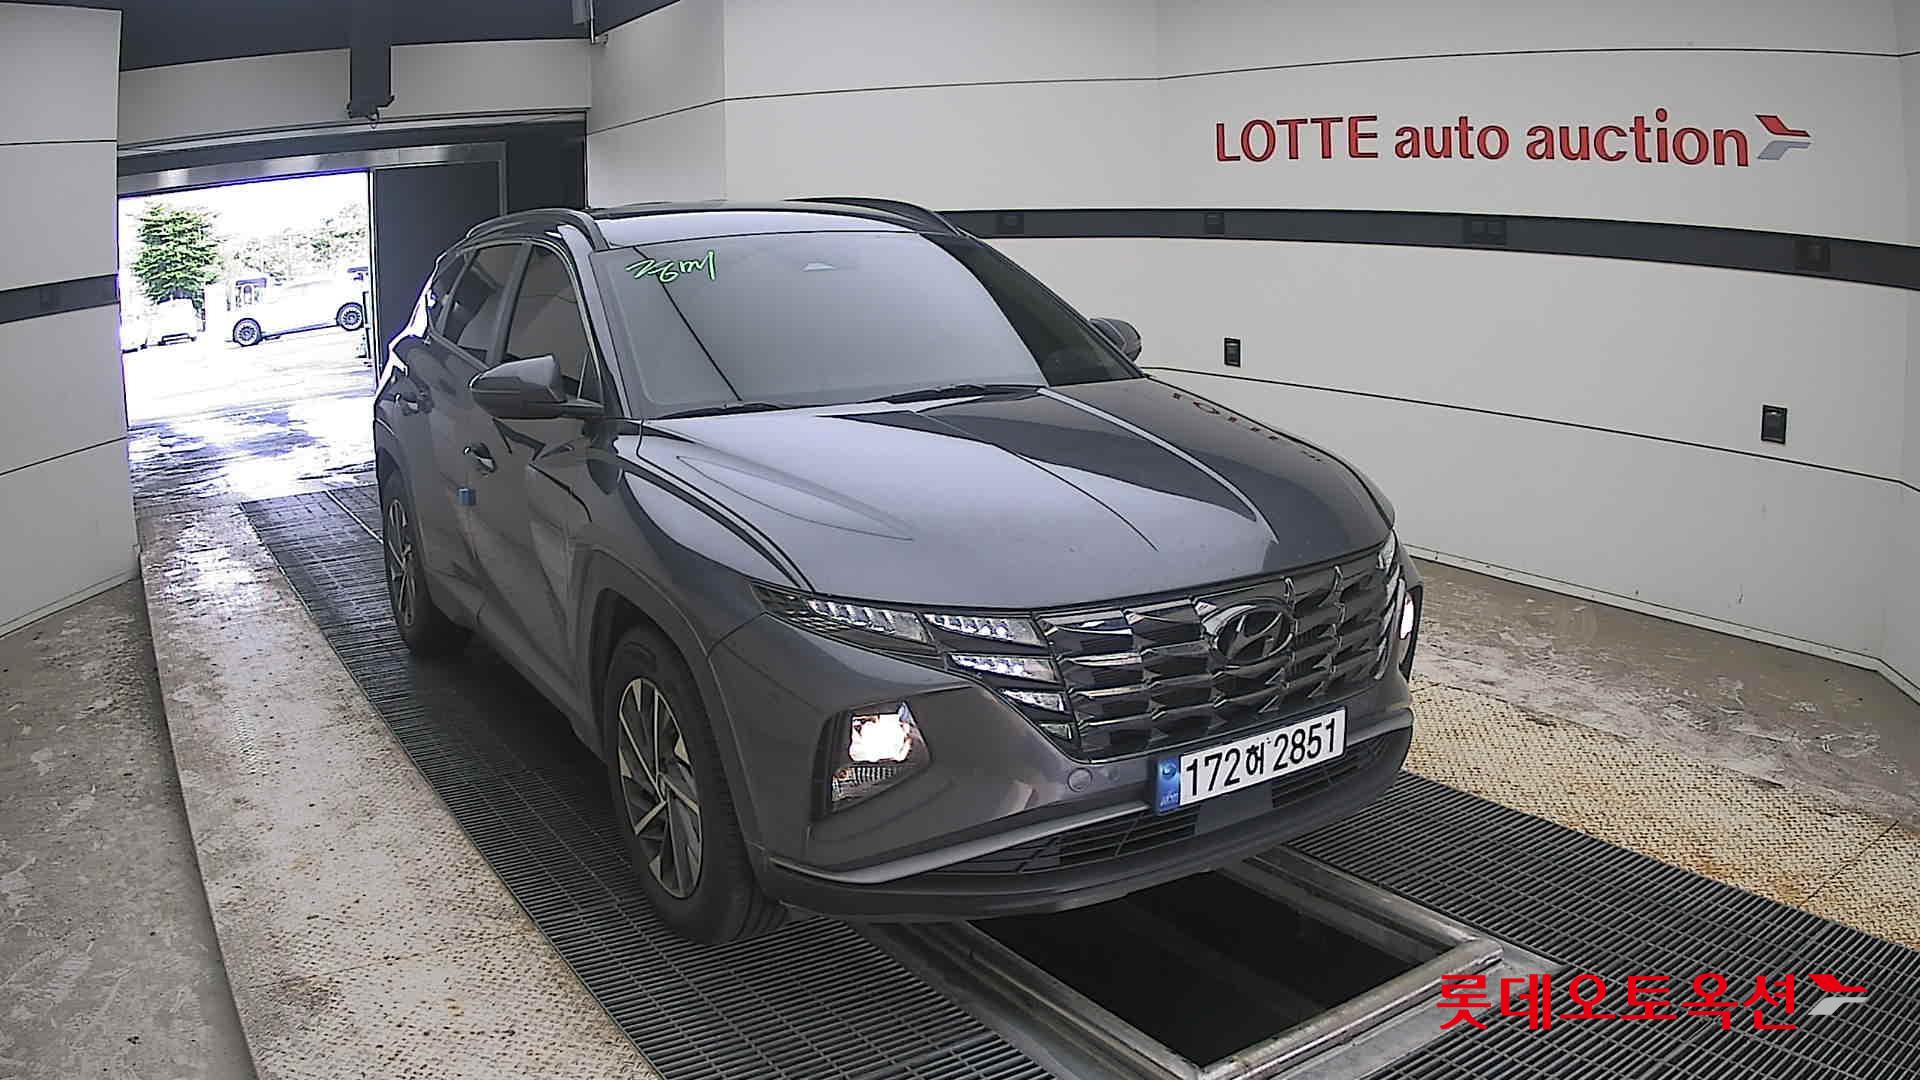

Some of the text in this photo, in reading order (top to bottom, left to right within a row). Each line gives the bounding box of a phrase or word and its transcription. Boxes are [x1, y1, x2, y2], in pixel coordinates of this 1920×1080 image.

[1216, 108, 1750, 167] LOTTE auto auction
[1273, 717, 1336, 772] 2851
